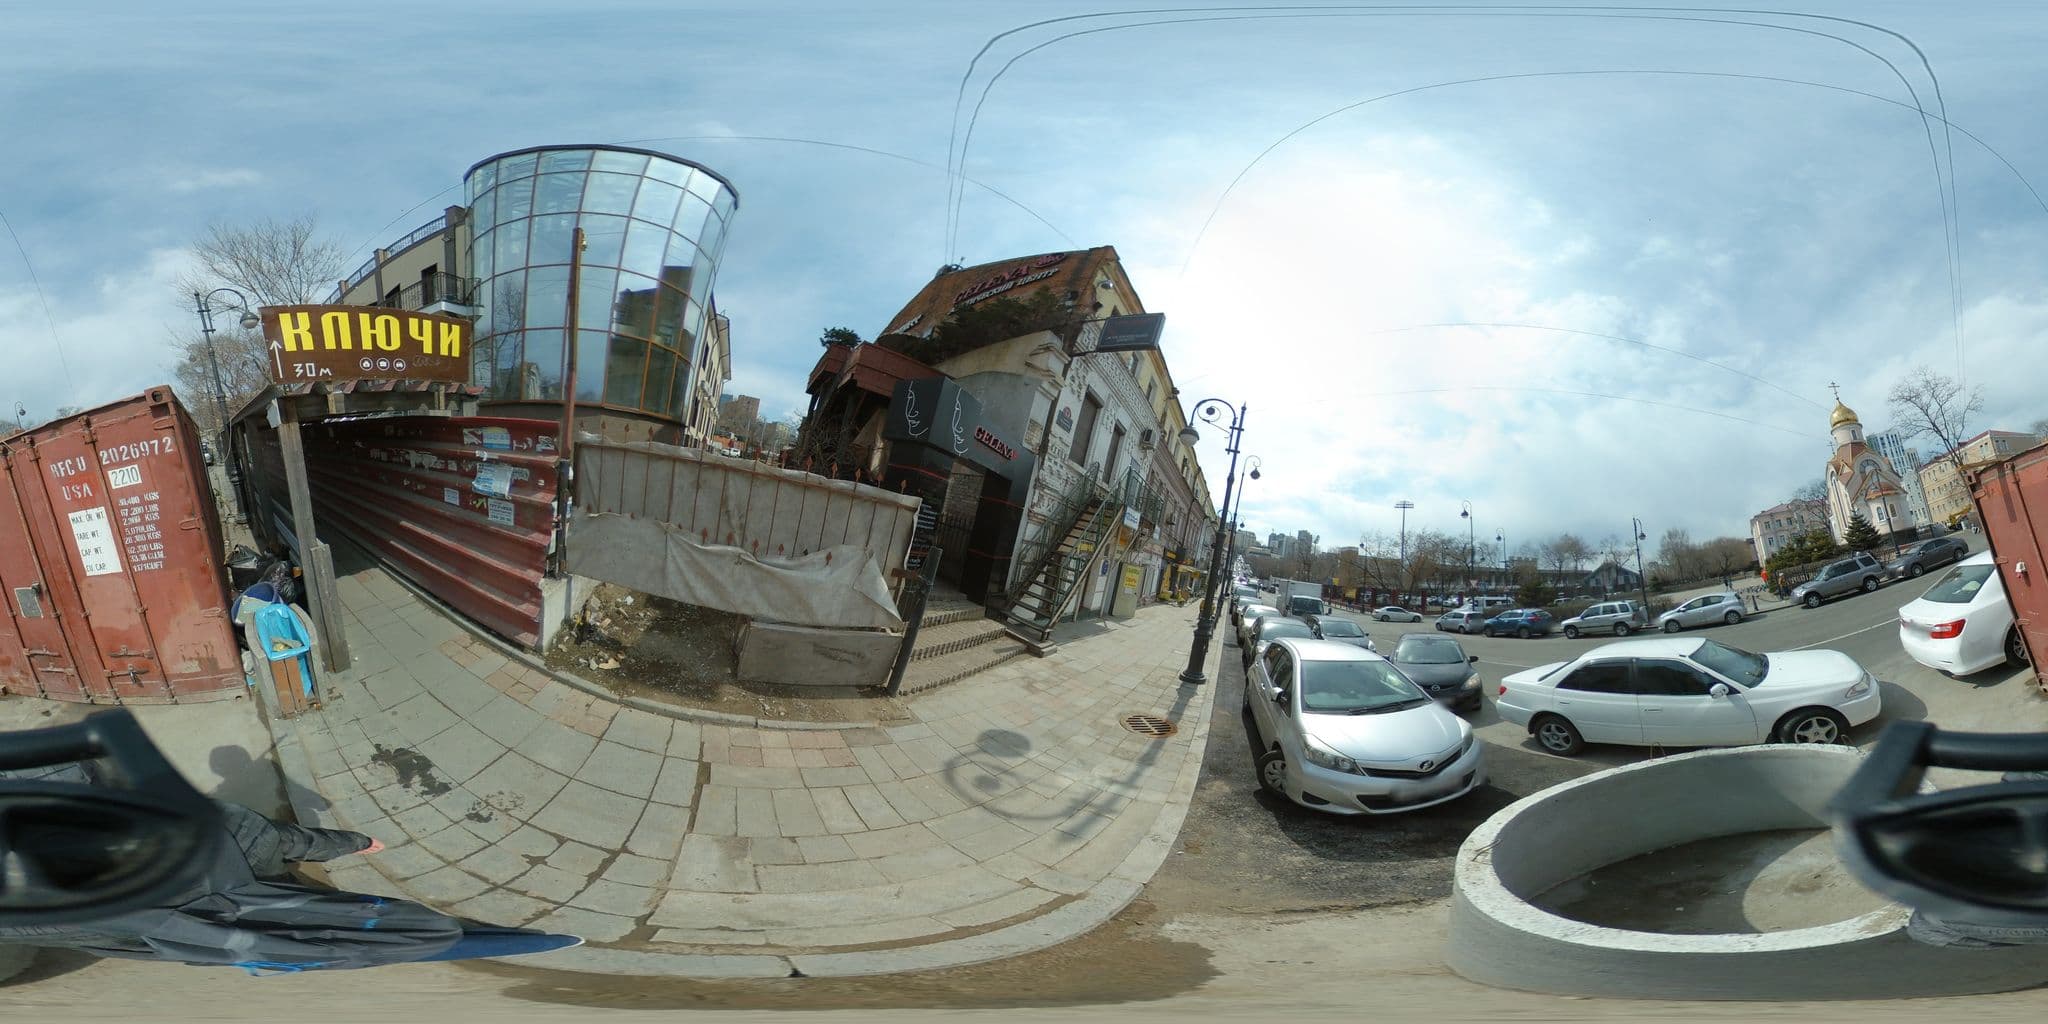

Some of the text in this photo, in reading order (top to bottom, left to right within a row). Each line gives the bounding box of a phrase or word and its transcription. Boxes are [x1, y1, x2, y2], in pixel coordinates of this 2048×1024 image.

[279, 312, 460, 357] КЛЮЧИ
[293, 363, 316, 378] 30
[100, 437, 173, 465] 2026972
[975, 424, 1017, 460] GELENA
[111, 466, 139, 487] 2210
[62, 483, 92, 501] USA
